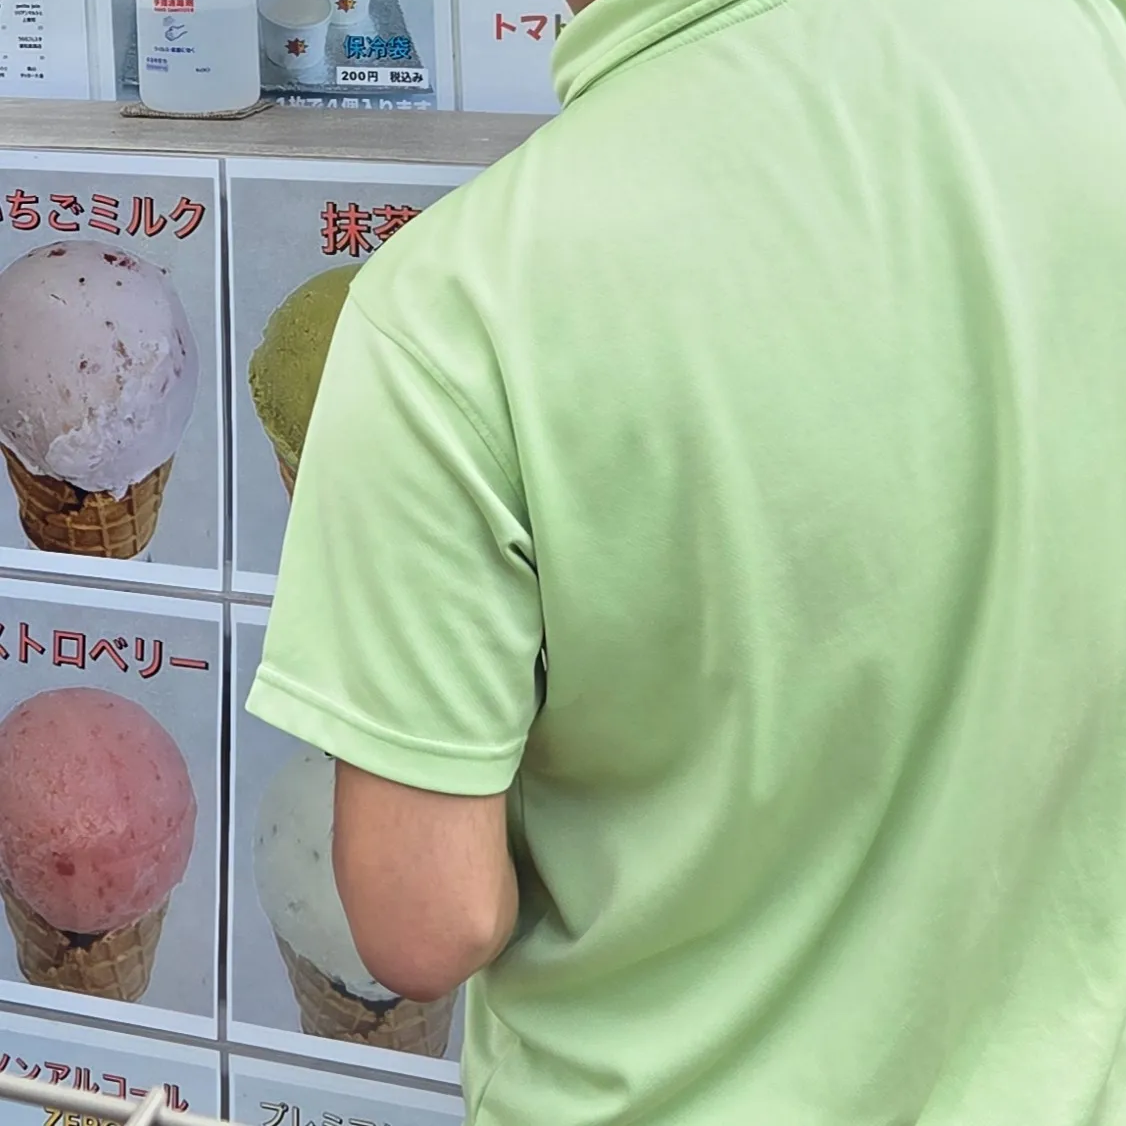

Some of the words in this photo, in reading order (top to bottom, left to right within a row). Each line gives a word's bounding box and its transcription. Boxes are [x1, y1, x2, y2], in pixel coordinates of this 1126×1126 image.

[343, 35, 413, 60] 保冷袋
[341, 70, 378, 82] 200円
[390, 71, 424, 83] 税込み
[0, 189, 206, 240] ちごミルク
